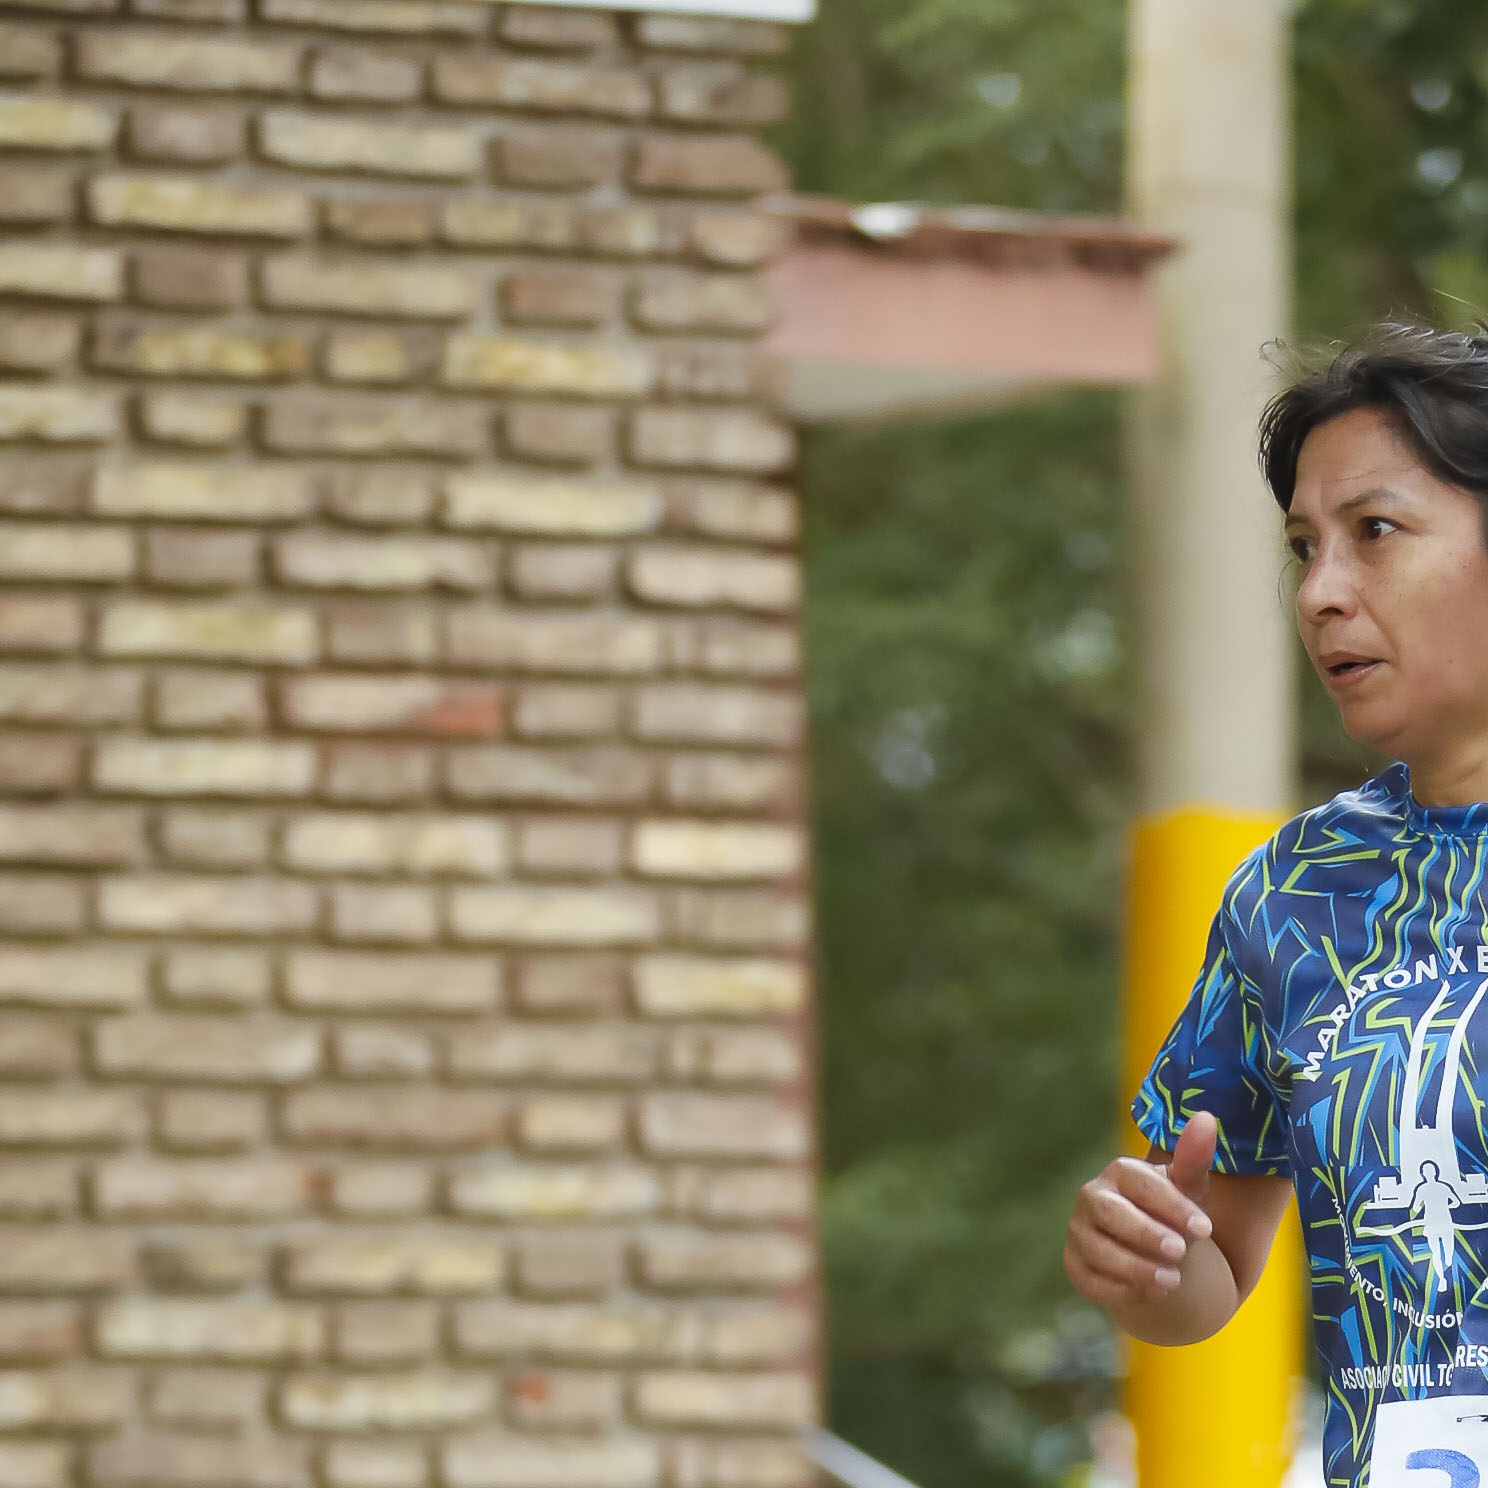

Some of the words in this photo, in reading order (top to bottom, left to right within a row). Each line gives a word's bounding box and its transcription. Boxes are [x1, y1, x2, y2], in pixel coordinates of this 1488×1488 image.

[1302, 953, 1439, 1082] MARATÓN
[1447, 945, 1469, 975] X
[1391, 1363, 1435, 1387] CIVIL
